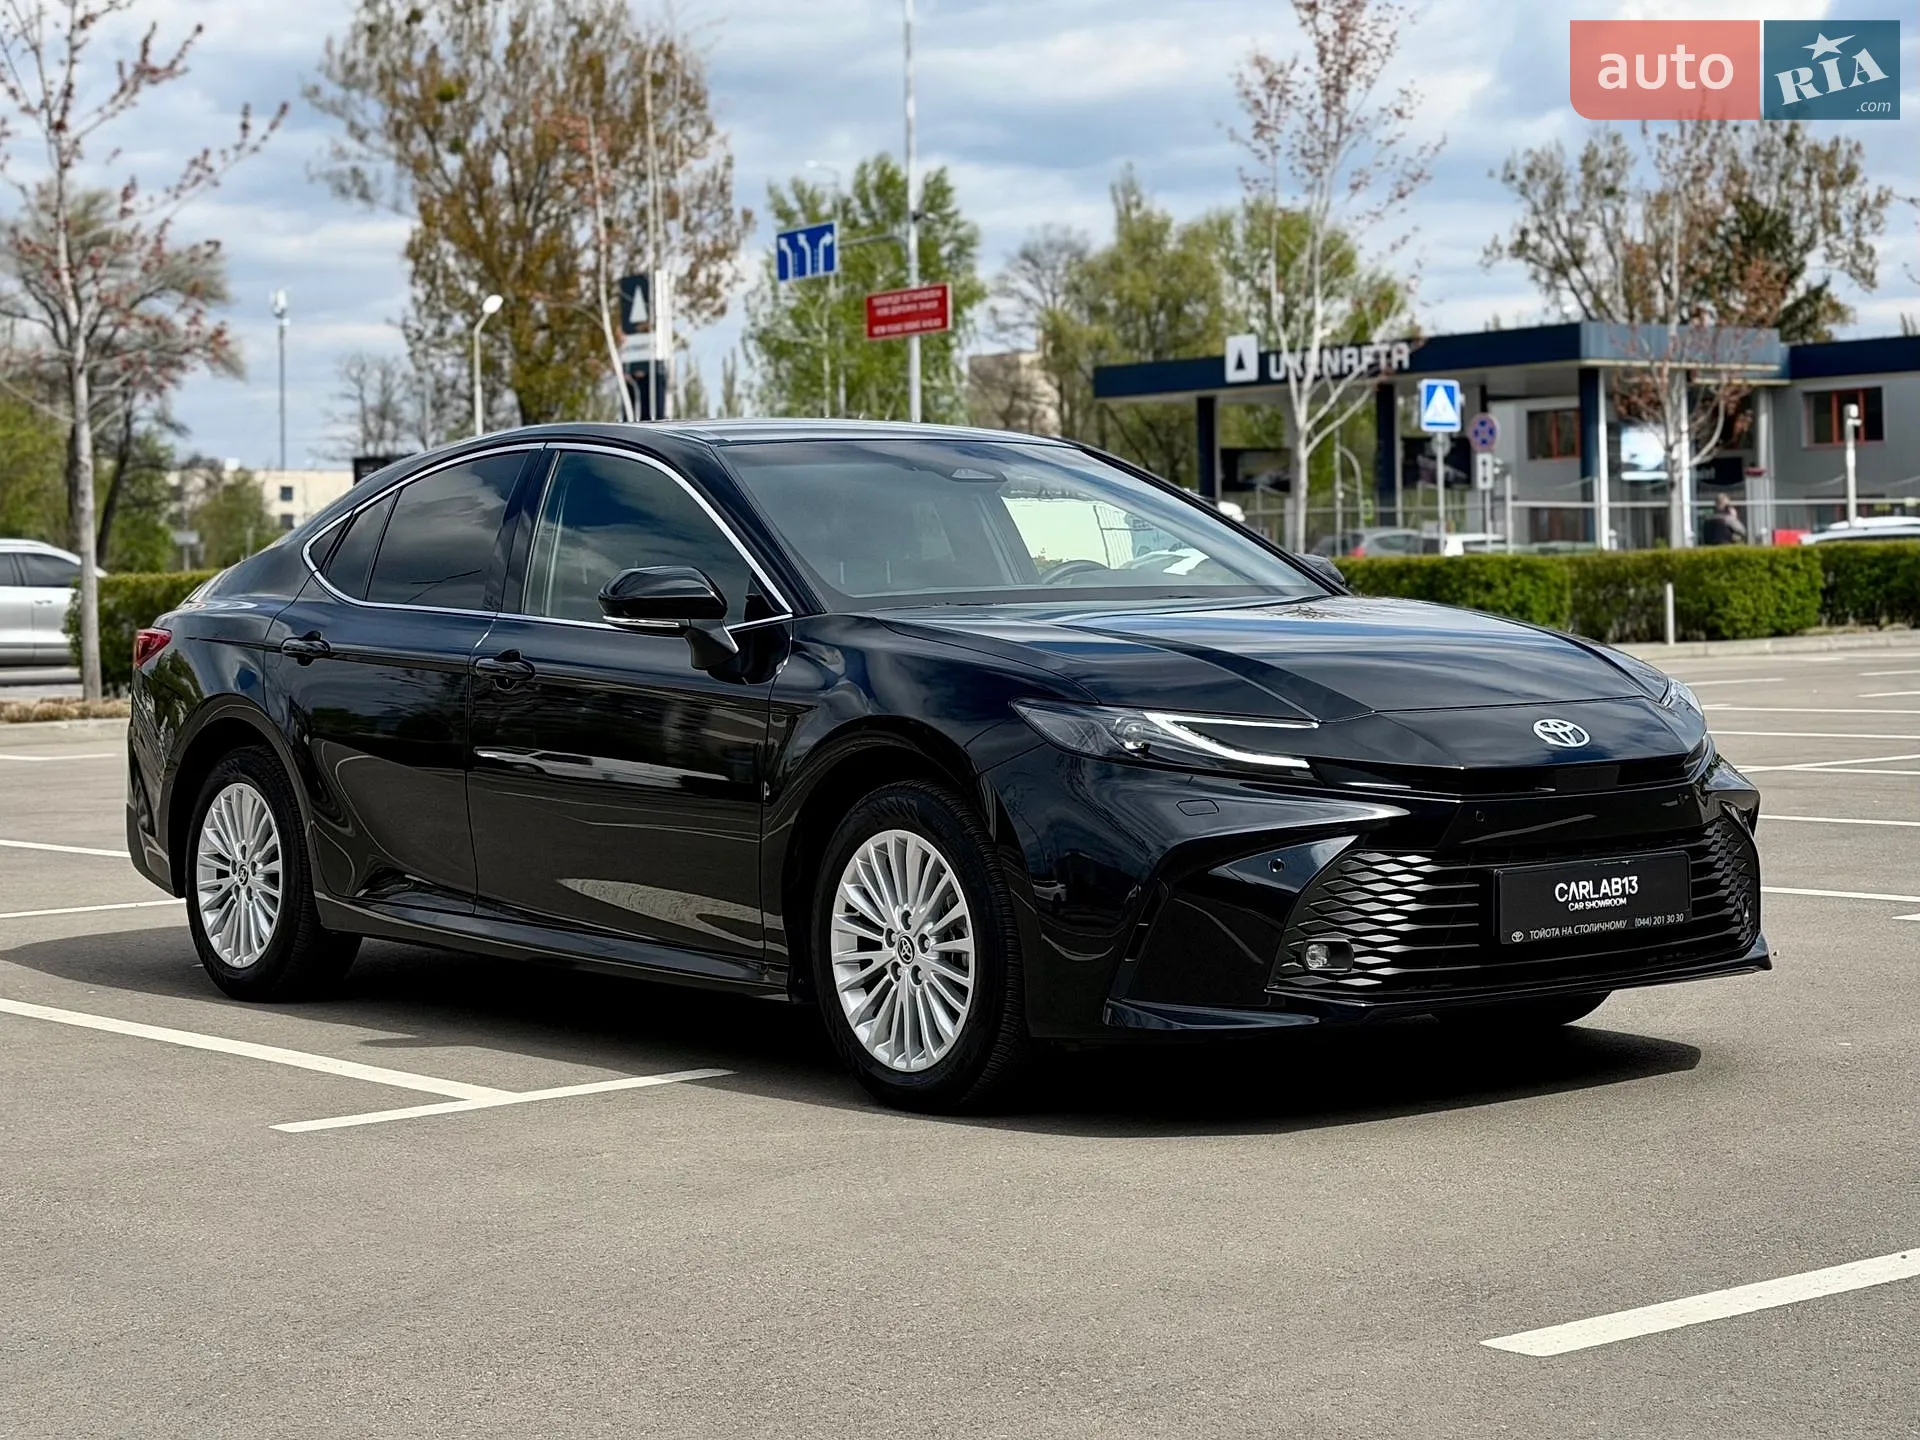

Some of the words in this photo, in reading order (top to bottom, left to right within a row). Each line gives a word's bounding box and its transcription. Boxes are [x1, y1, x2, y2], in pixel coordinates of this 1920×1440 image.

[1554, 875, 1639, 902] CARLAB13
[1568, 902, 1584, 911] CAR
[1585, 898, 1627, 910] SHOWROOM
[1530, 927, 1560, 940] ТОЙОТА
[1562, 926, 1573, 936] НА
[1574, 920, 1627, 935] СТОЛИЧНОМУ
[1634, 916, 1652, 928] (044)
[1653, 914, 1665, 925] 201
[1666, 914, 1675, 924] 30
[1675, 913, 1684, 922] 30
